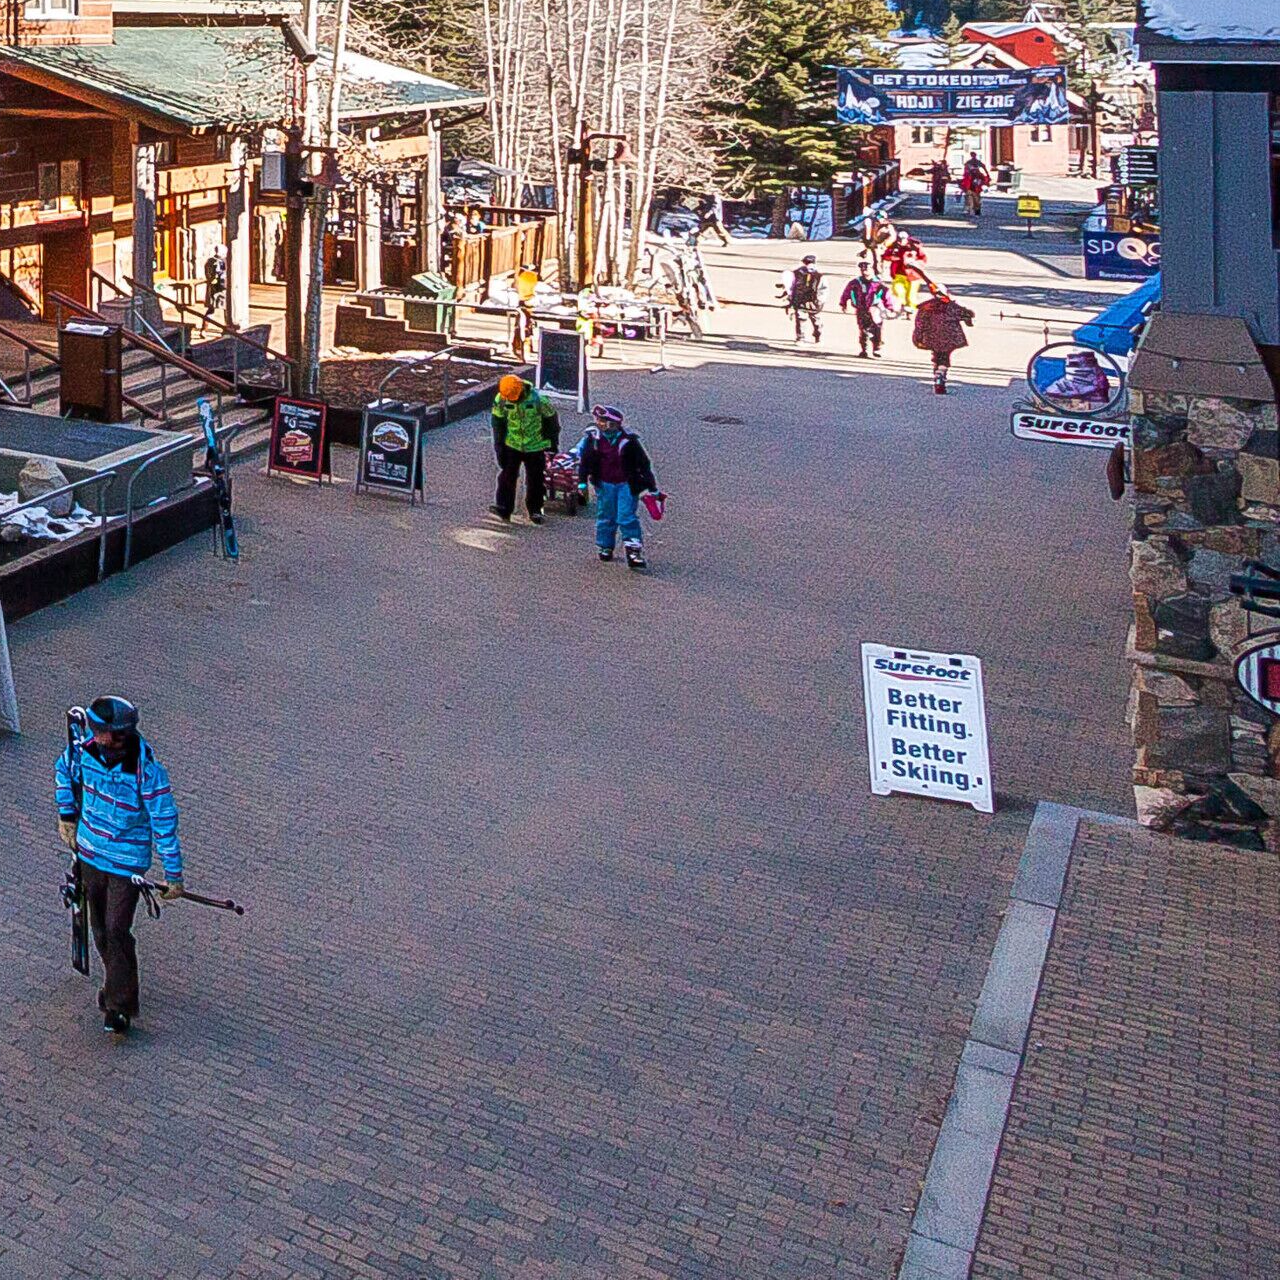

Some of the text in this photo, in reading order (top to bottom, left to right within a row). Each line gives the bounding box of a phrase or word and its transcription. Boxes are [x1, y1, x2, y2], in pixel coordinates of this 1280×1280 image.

[873, 75, 903, 86] GET
[956, 94, 1015, 109] ZIG ZAG
[1019, 416, 1131, 438] Surefoot
[873, 658, 971, 680] Surefoot
[888, 688, 962, 713] Better
[887, 709, 973, 739] Fitting.
[891, 738, 967, 764] Better
[892, 759, 977, 791] Skiing.
